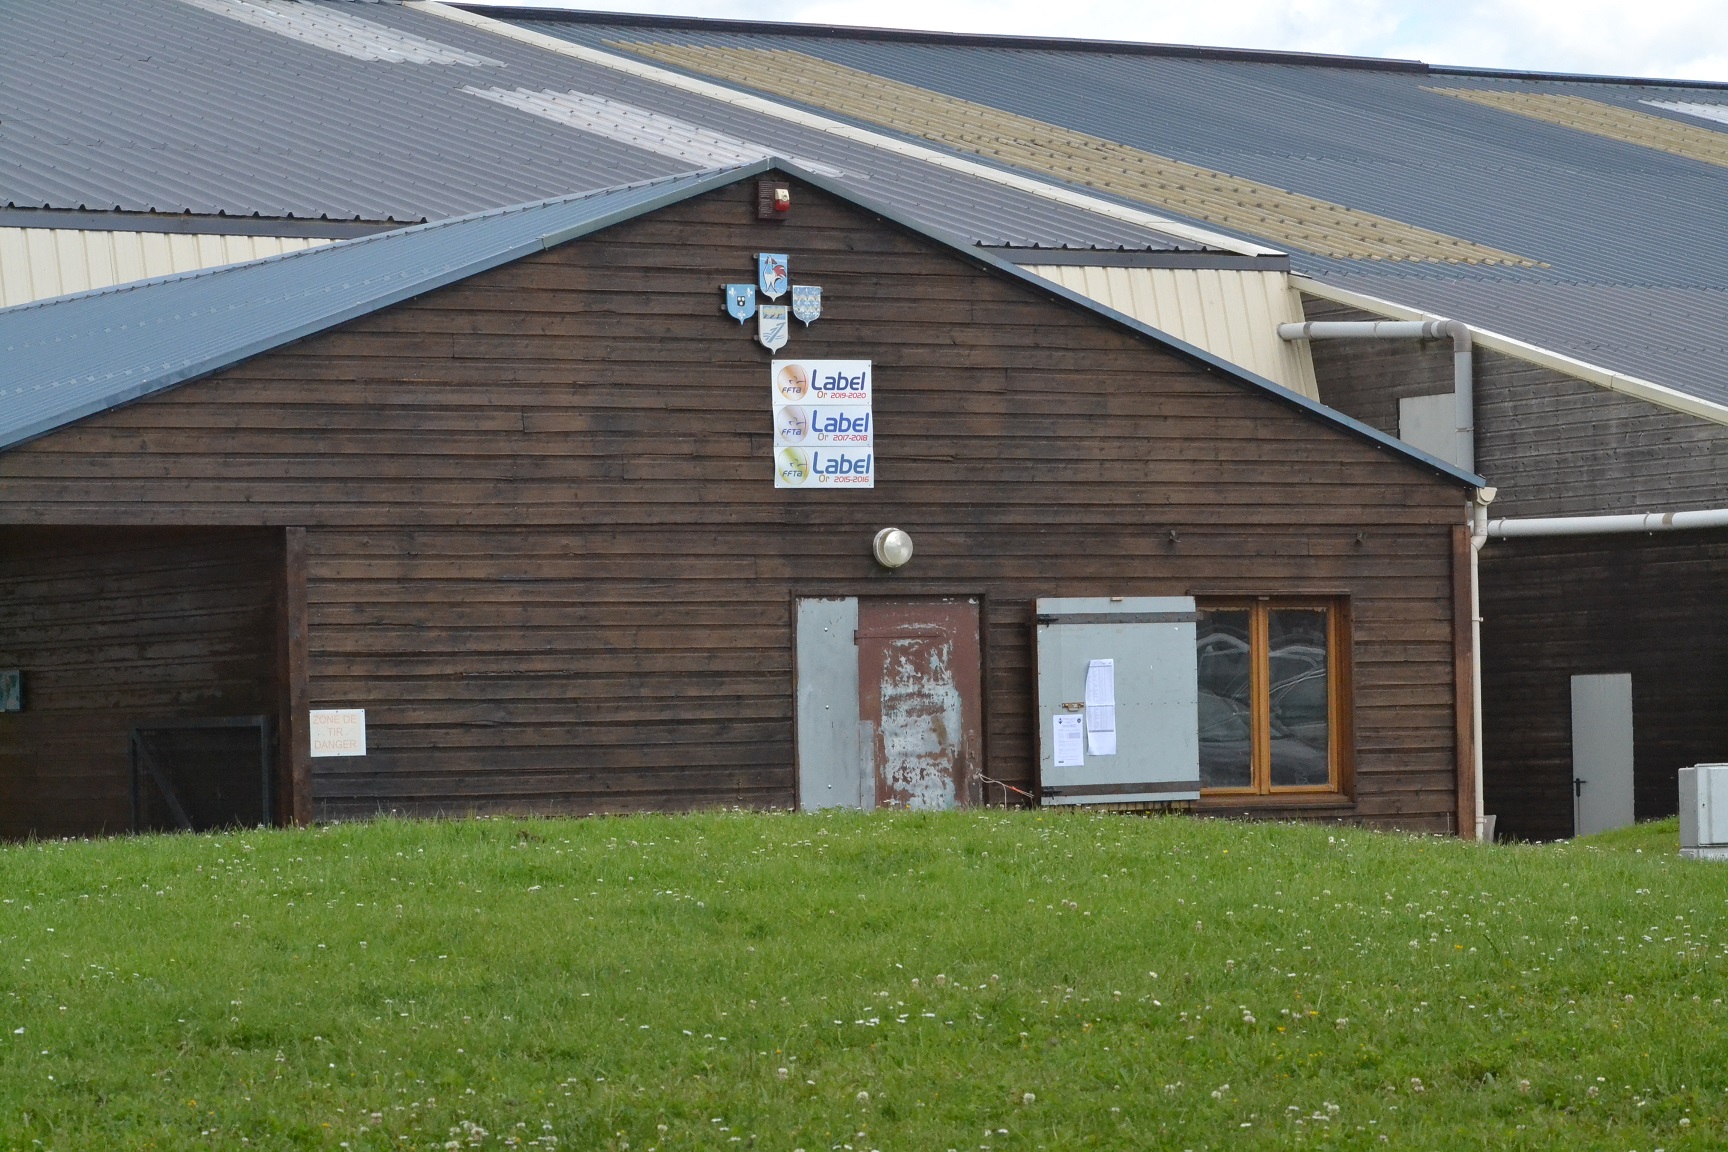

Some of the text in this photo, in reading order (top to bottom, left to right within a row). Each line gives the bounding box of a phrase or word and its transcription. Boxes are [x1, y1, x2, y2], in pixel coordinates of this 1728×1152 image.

[811, 369, 866, 391] Label
[817, 390, 828, 399] Or
[812, 409, 870, 433] Label
[817, 432, 868, 442] Or 2017-2018
[812, 451, 872, 475] Label
[818, 474, 870, 483] Or 2015-2016
[312, 714, 358, 725] ZONE DE
[328, 727, 344, 737] TIR
[314, 739, 357, 750] DANGER
